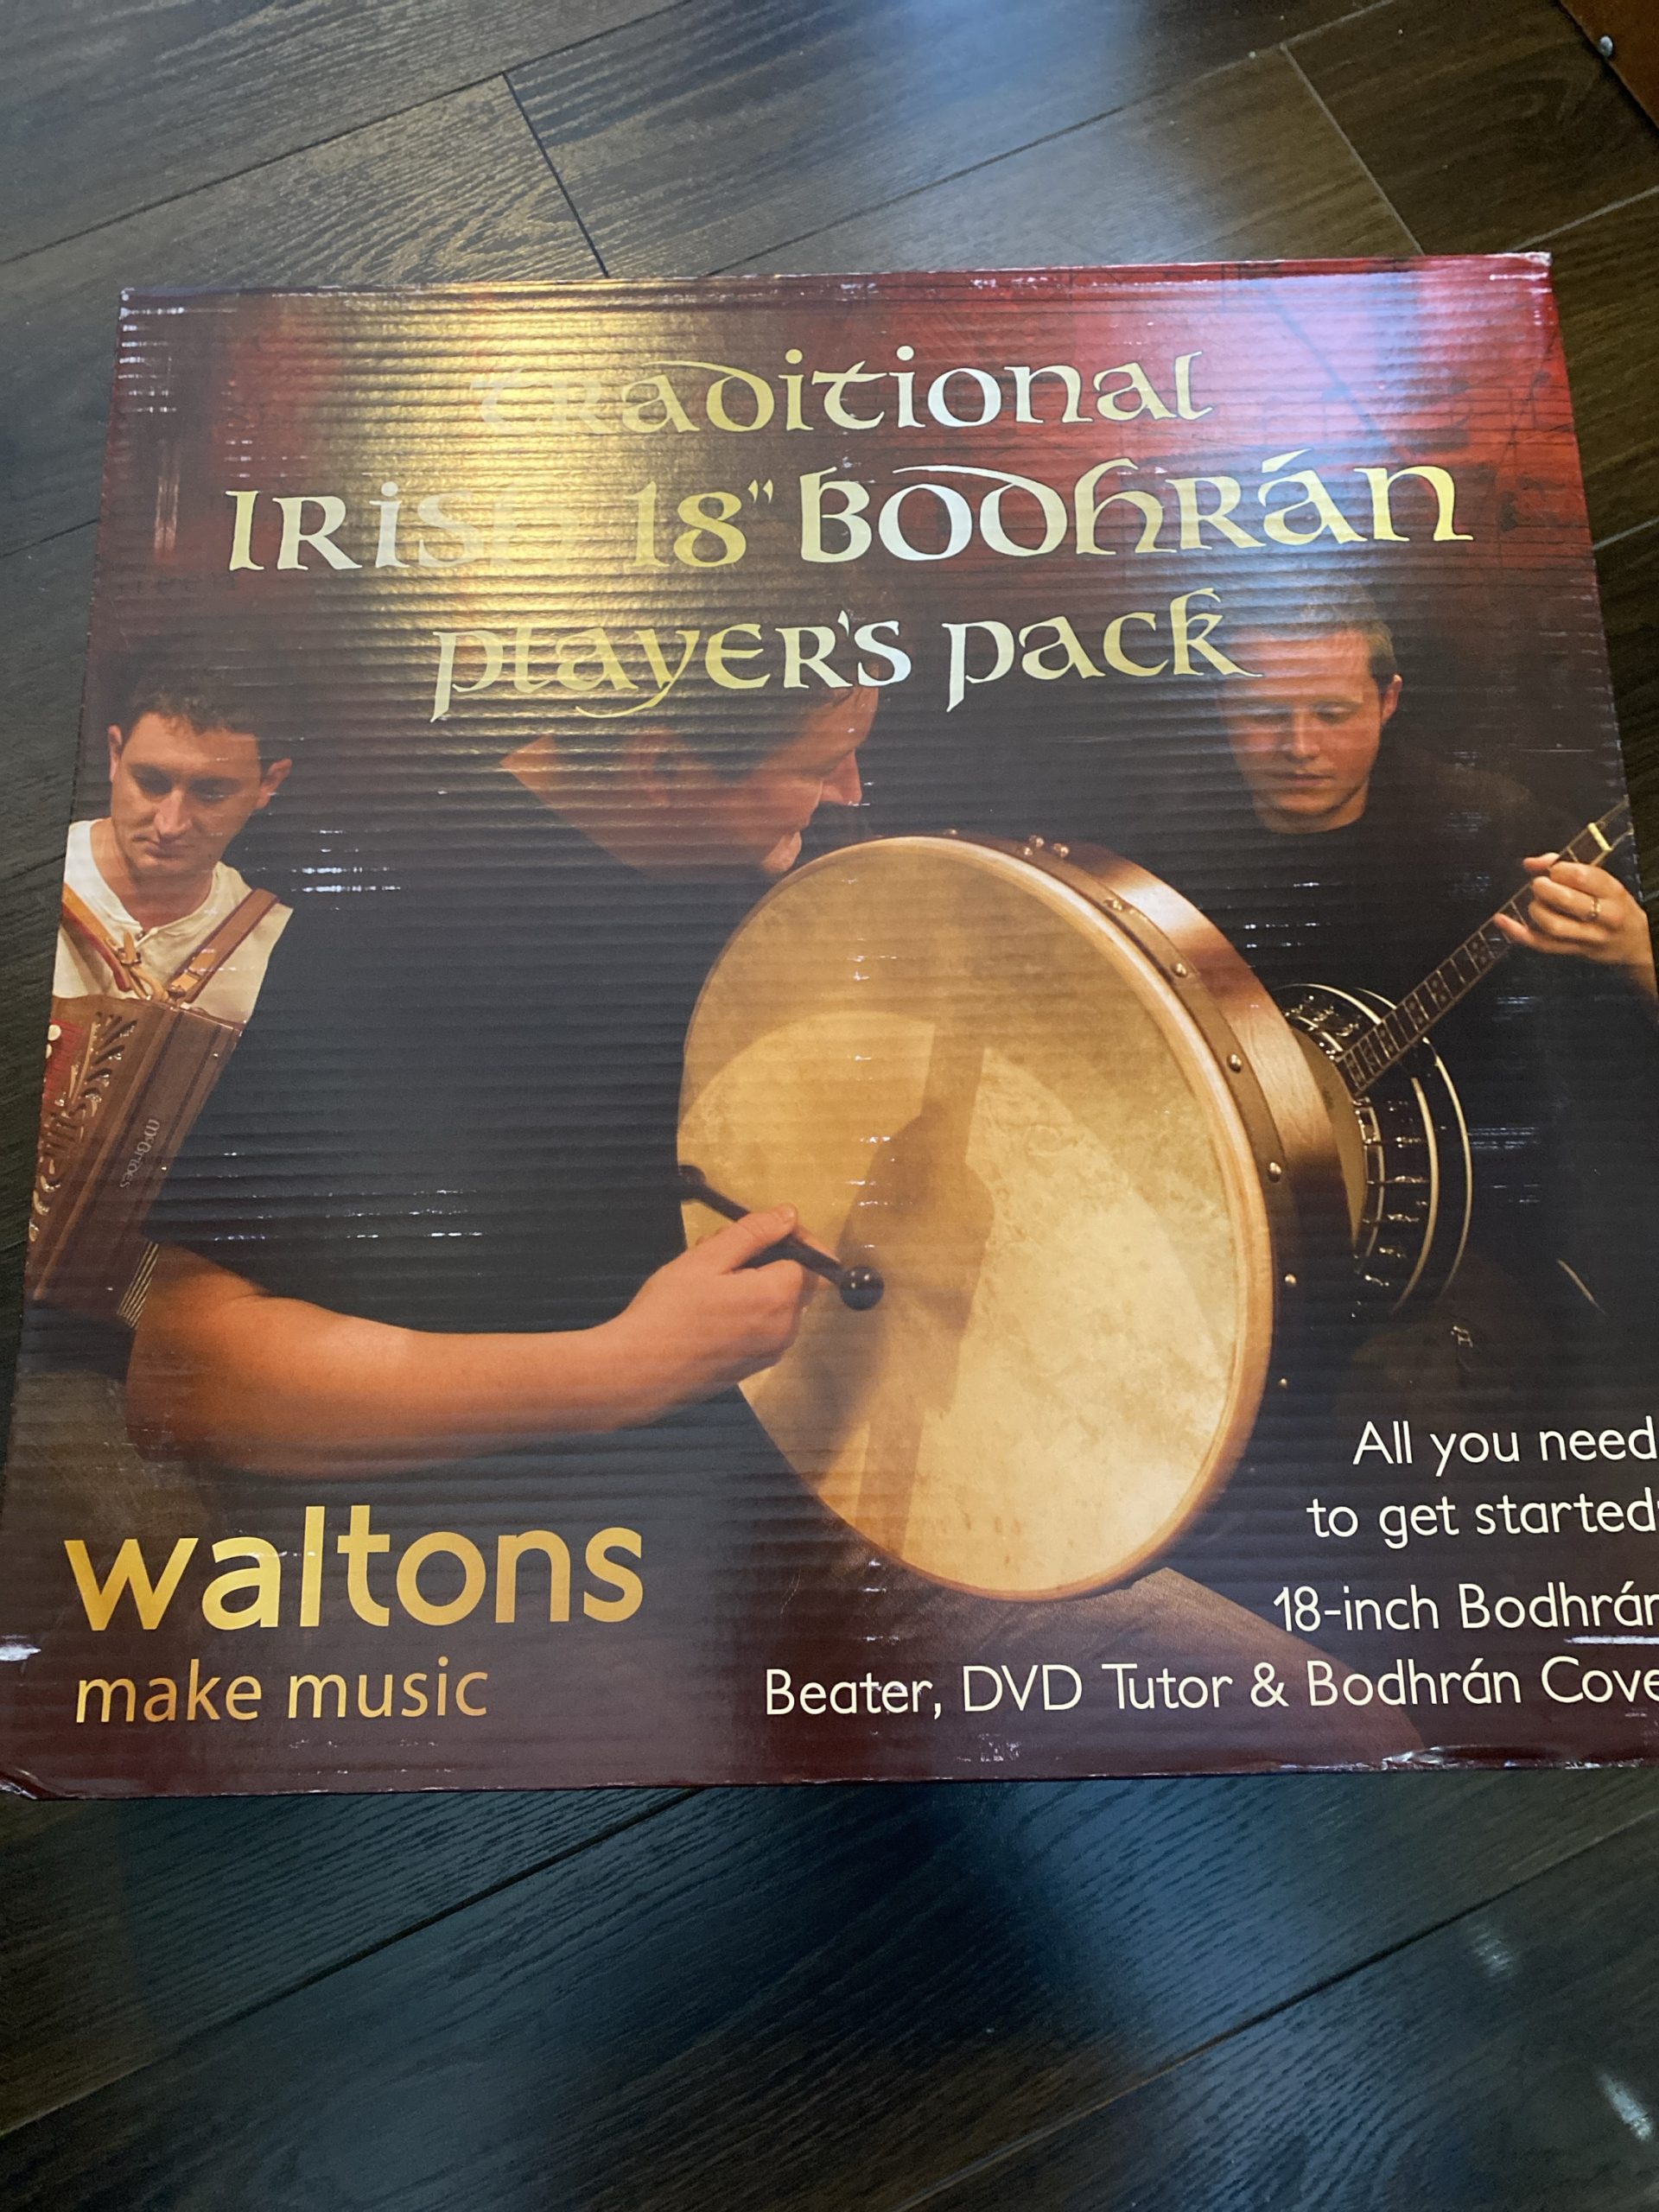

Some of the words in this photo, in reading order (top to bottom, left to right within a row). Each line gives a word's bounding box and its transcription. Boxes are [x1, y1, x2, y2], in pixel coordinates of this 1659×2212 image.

[799, 448, 1474, 563] Bodhrán
[940, 587, 1263, 713] pack
[1353, 1420, 1414, 1465] All
[1429, 1430, 1521, 1478] you
[1539, 1414, 1658, 1462] need
[1306, 1498, 1359, 1538] to
[1379, 1496, 1460, 1549] get
[1475, 1486, 1659, 1535] started
[64, 1504, 645, 1631] waltons
[1273, 1584, 1440, 1632] 18-inch
[76, 1658, 262, 1723] make
[288, 1656, 488, 1719] music
[766, 1669, 942, 1720] Beater,
[963, 1664, 1083, 1713] DVD
[1101, 1662, 1233, 1710] Tutor
[1249, 1662, 1289, 1707] &
[1306, 1657, 1522, 1707] Bodhrán
